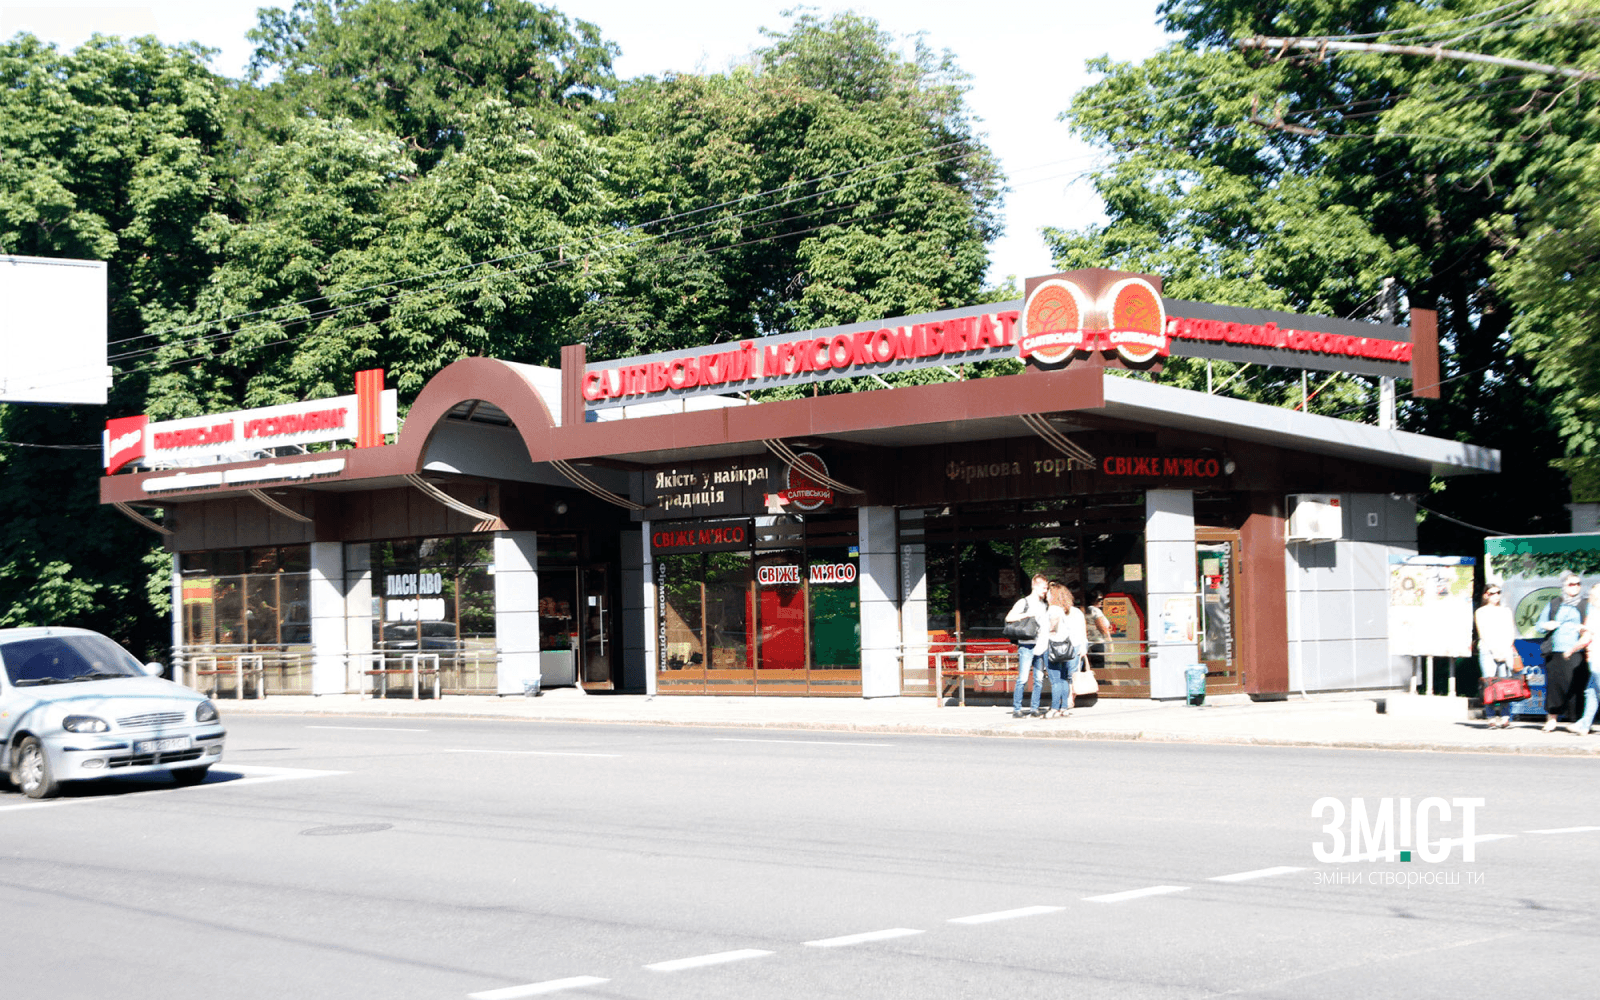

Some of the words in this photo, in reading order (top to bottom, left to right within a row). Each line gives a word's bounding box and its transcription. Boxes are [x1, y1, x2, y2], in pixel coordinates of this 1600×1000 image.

[581, 341, 760, 400] САЛТІВСЬКИЙ
[763, 310, 1022, 376] М'ЯСОКОМБІНАТ
[655, 470, 698, 488] Якість
[702, 473, 710, 489] у
[714, 466, 769, 485] найкра
[945, 461, 1021, 483] Фірмова
[1103, 456, 1160, 476] СВІЖЕ
[1163, 456, 1219, 477] М'ЯСО
[657, 486, 724, 510] традиція
[787, 490, 831, 499] САЛТІВСЬКИЙ
[652, 529, 695, 548] СВІЖЕ
[699, 526, 744, 544] М'ЯСО
[758, 565, 800, 584] СВІЖЕ
[809, 563, 856, 583] М'ЯСО
[658, 563, 667, 616] Фірмова
